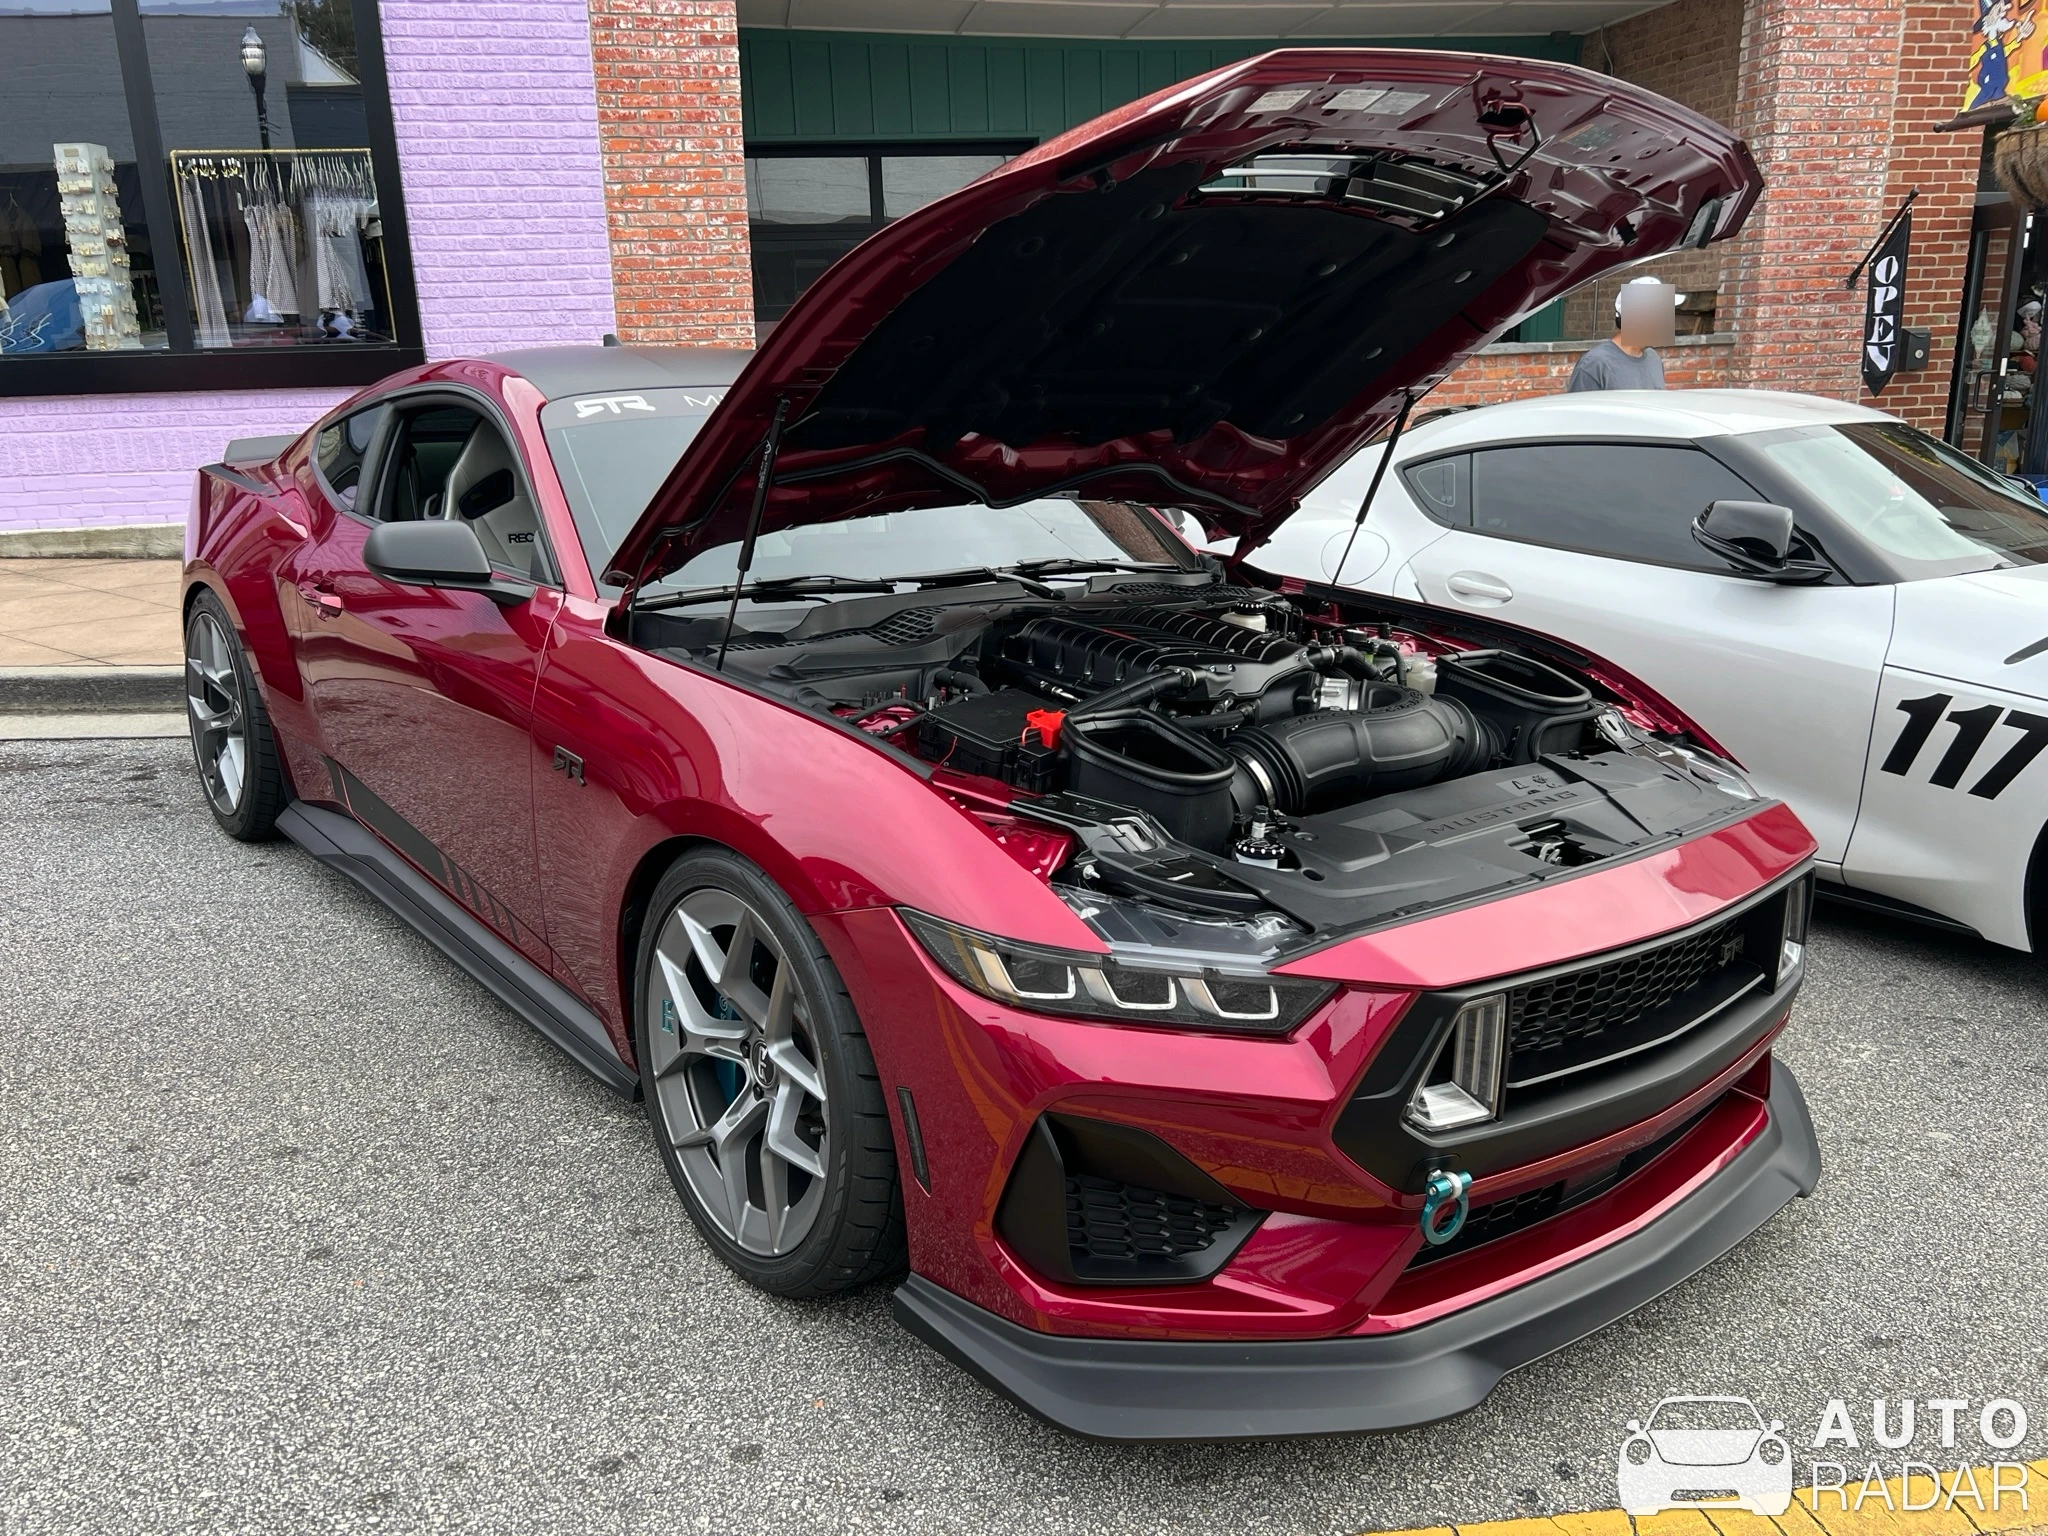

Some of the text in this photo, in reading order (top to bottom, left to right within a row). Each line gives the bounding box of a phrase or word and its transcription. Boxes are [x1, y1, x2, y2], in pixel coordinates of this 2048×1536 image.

[1863, 255, 1899, 372] OPEN
[1880, 693, 2048, 800] 117
[1425, 790, 1578, 835] MUSTANG
